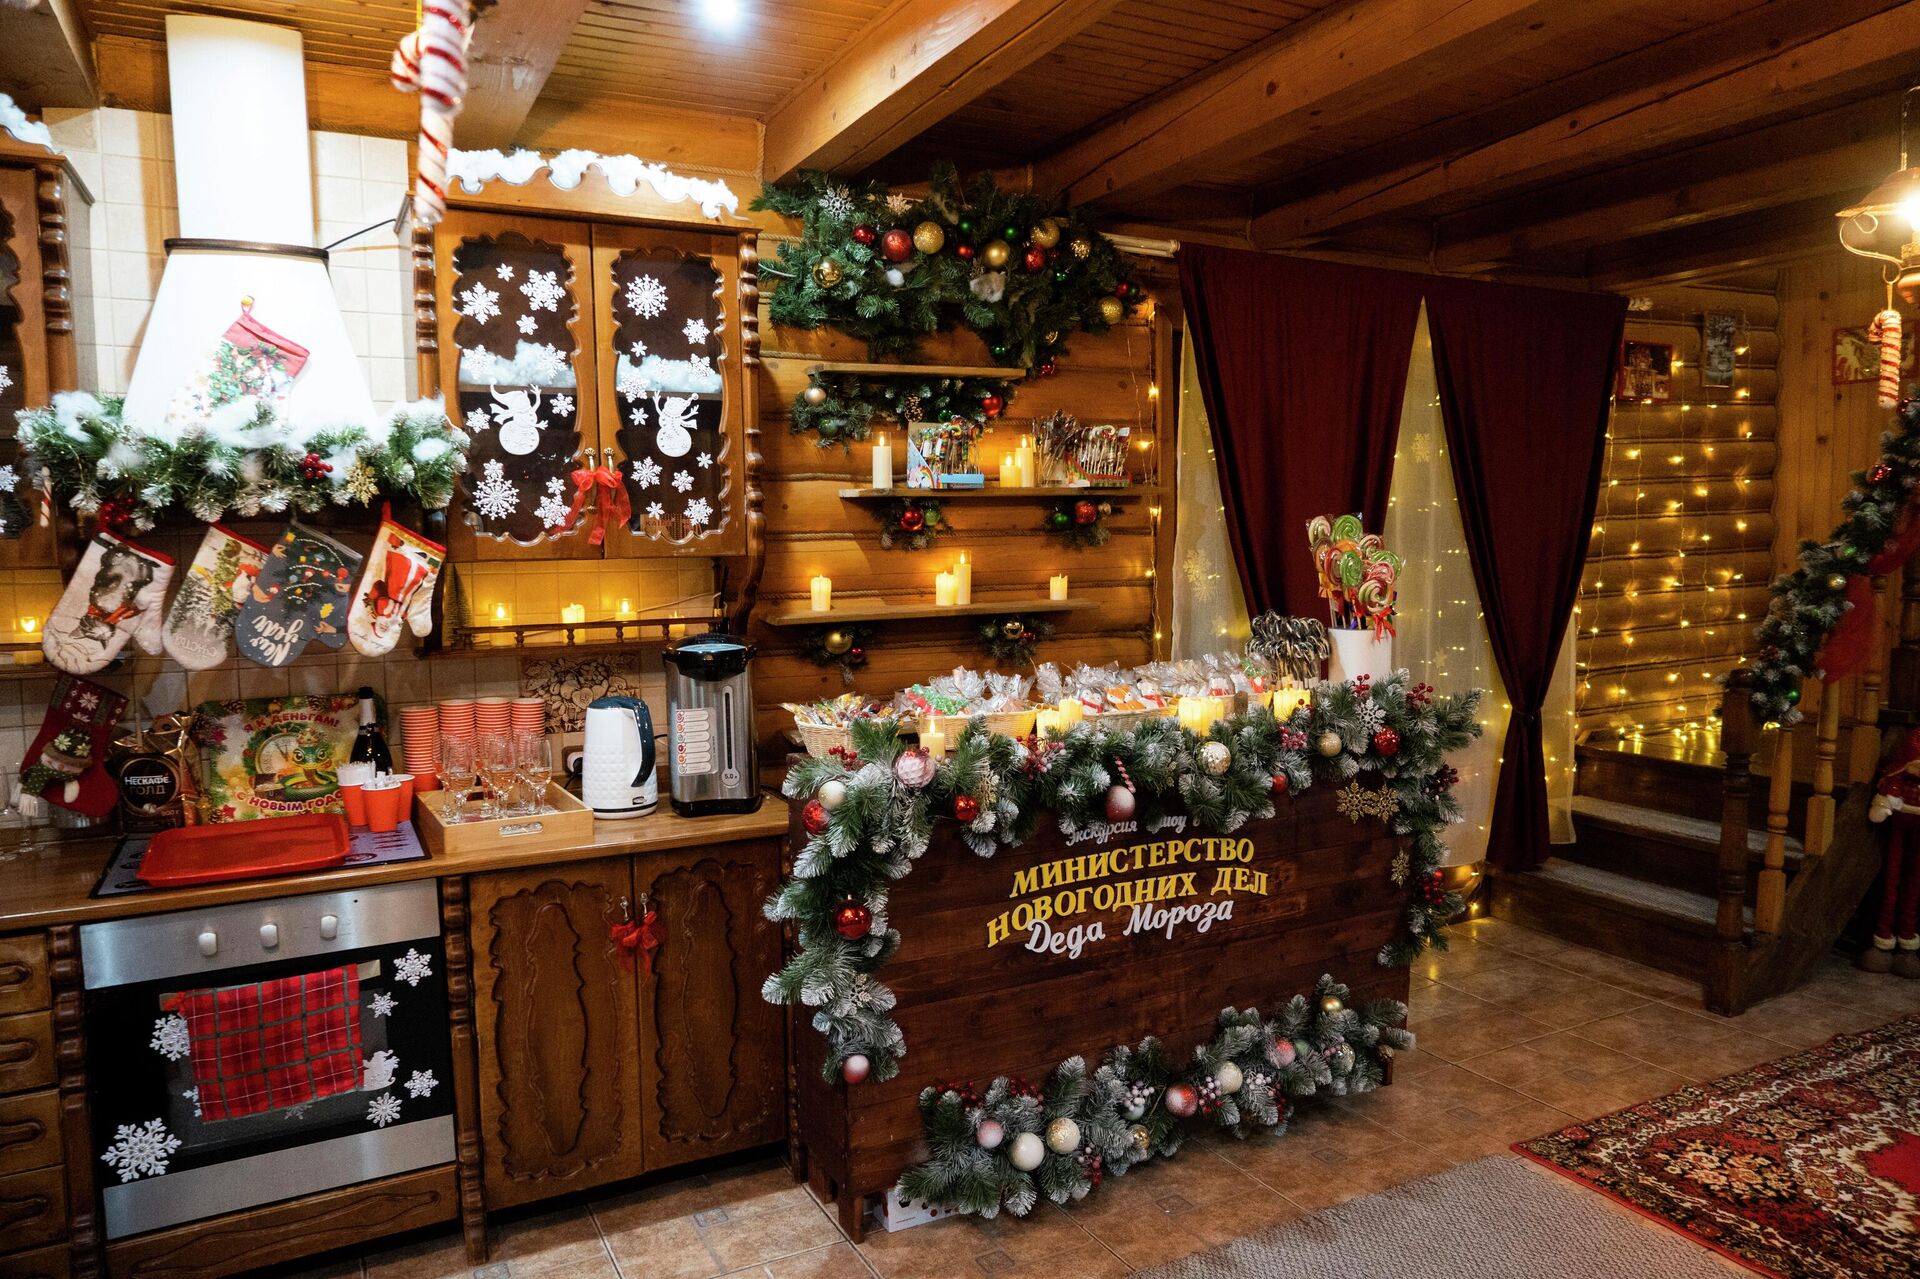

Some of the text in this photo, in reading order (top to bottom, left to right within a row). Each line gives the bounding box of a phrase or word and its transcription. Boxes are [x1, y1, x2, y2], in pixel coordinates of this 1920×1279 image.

[251, 615, 304, 643] year
[250, 637, 291, 666] New
[271, 711, 339, 727] ДЕНЬГАМ!
[129, 785, 167, 796] ГОЛД
[236, 790, 343, 812] С НОВЫМ ГОДО
[1065, 820, 1138, 847] Экскурсия
[1009, 837, 1255, 899] МИНИСТЕРСТВО
[987, 867, 1269, 949] НОВОГОДНИХ ДЕЛ
[1025, 900, 1235, 960] Деда Мороза
